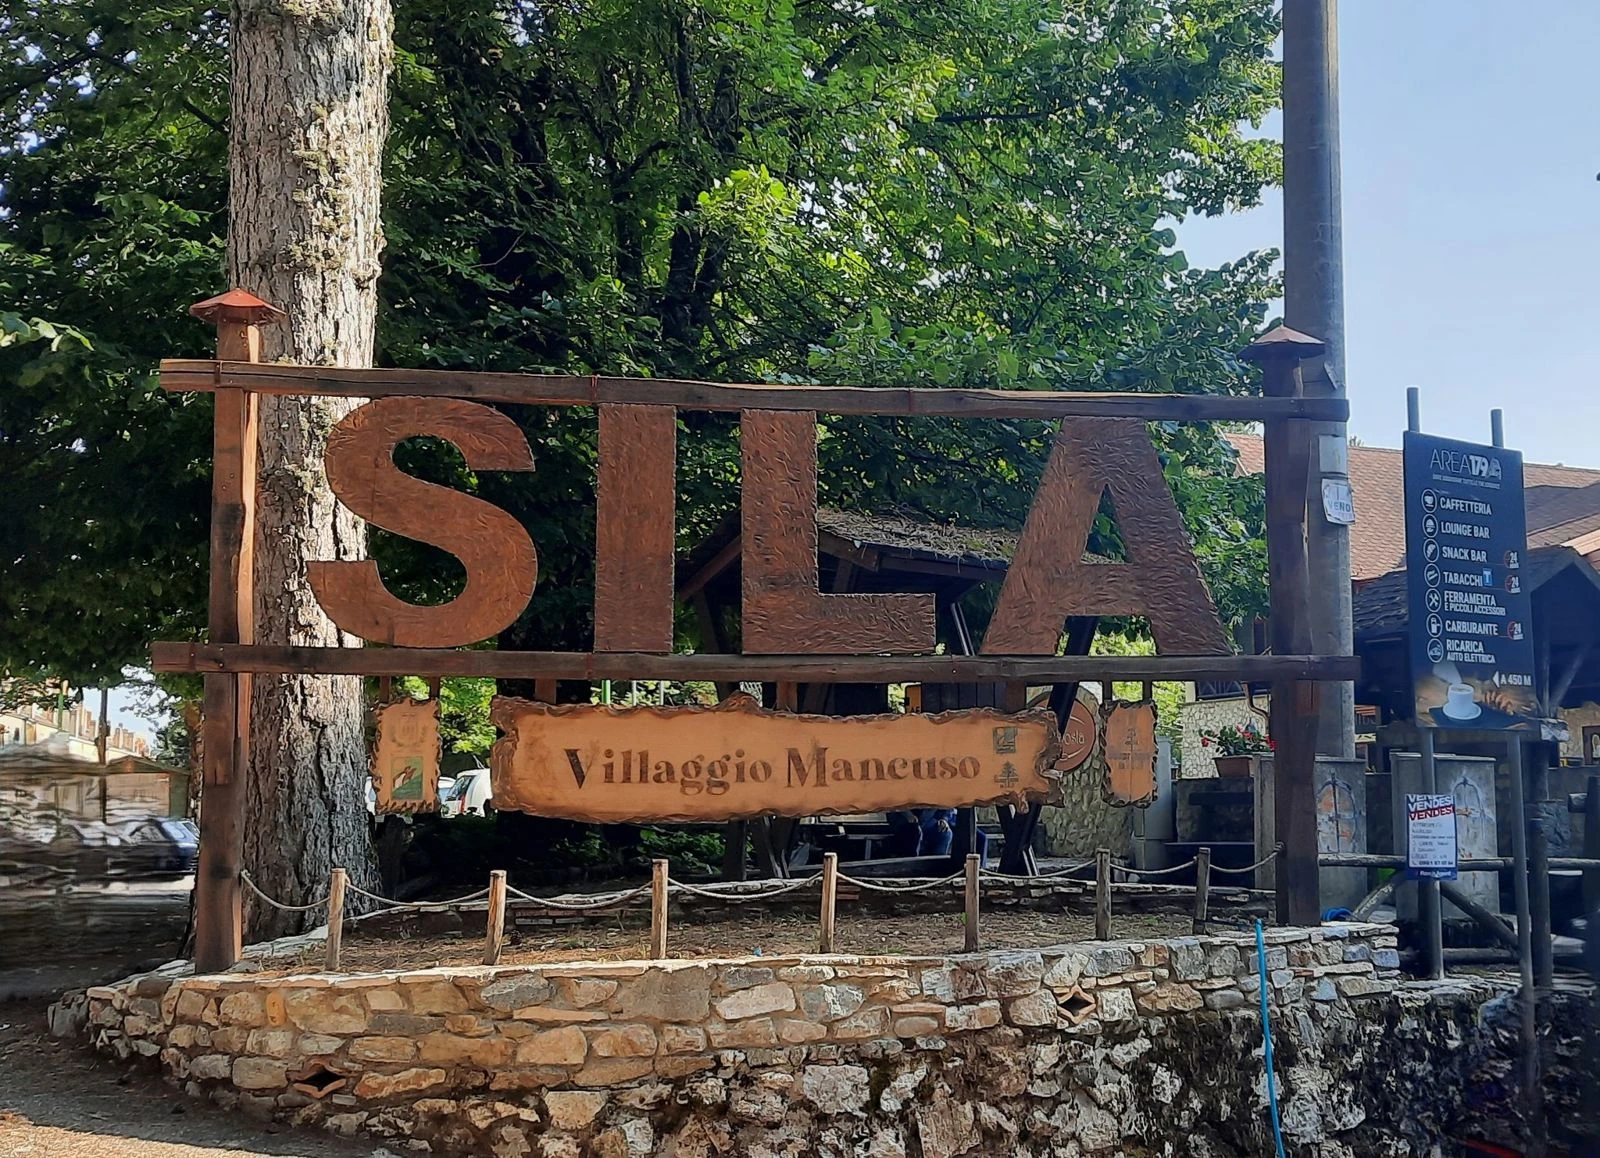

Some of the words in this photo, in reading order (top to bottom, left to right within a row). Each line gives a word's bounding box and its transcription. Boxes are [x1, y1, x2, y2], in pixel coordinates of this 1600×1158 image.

[1440, 497, 1492, 515] CAFFETTERIA
[305, 397, 1232, 656] SILA
[1441, 521, 1473, 537] LOUNGE
[1473, 526, 1490, 539] BAR
[1442, 546, 1470, 561] SNACK
[1470, 550, 1487, 563] BAR
[1443, 571, 1483, 587] TABACCHI
[1444, 590, 1496, 606] FERRAMENTA
[1445, 620, 1499, 636] CARBURANTE
[1446, 638, 1484, 653] RICARICA
[1500, 673, 1507, 685] A
[1507, 674, 1522, 686] 450
[1523, 675, 1532, 686] M
[563, 747, 773, 796] Villaggio
[784, 745, 981, 789] Mancuso
